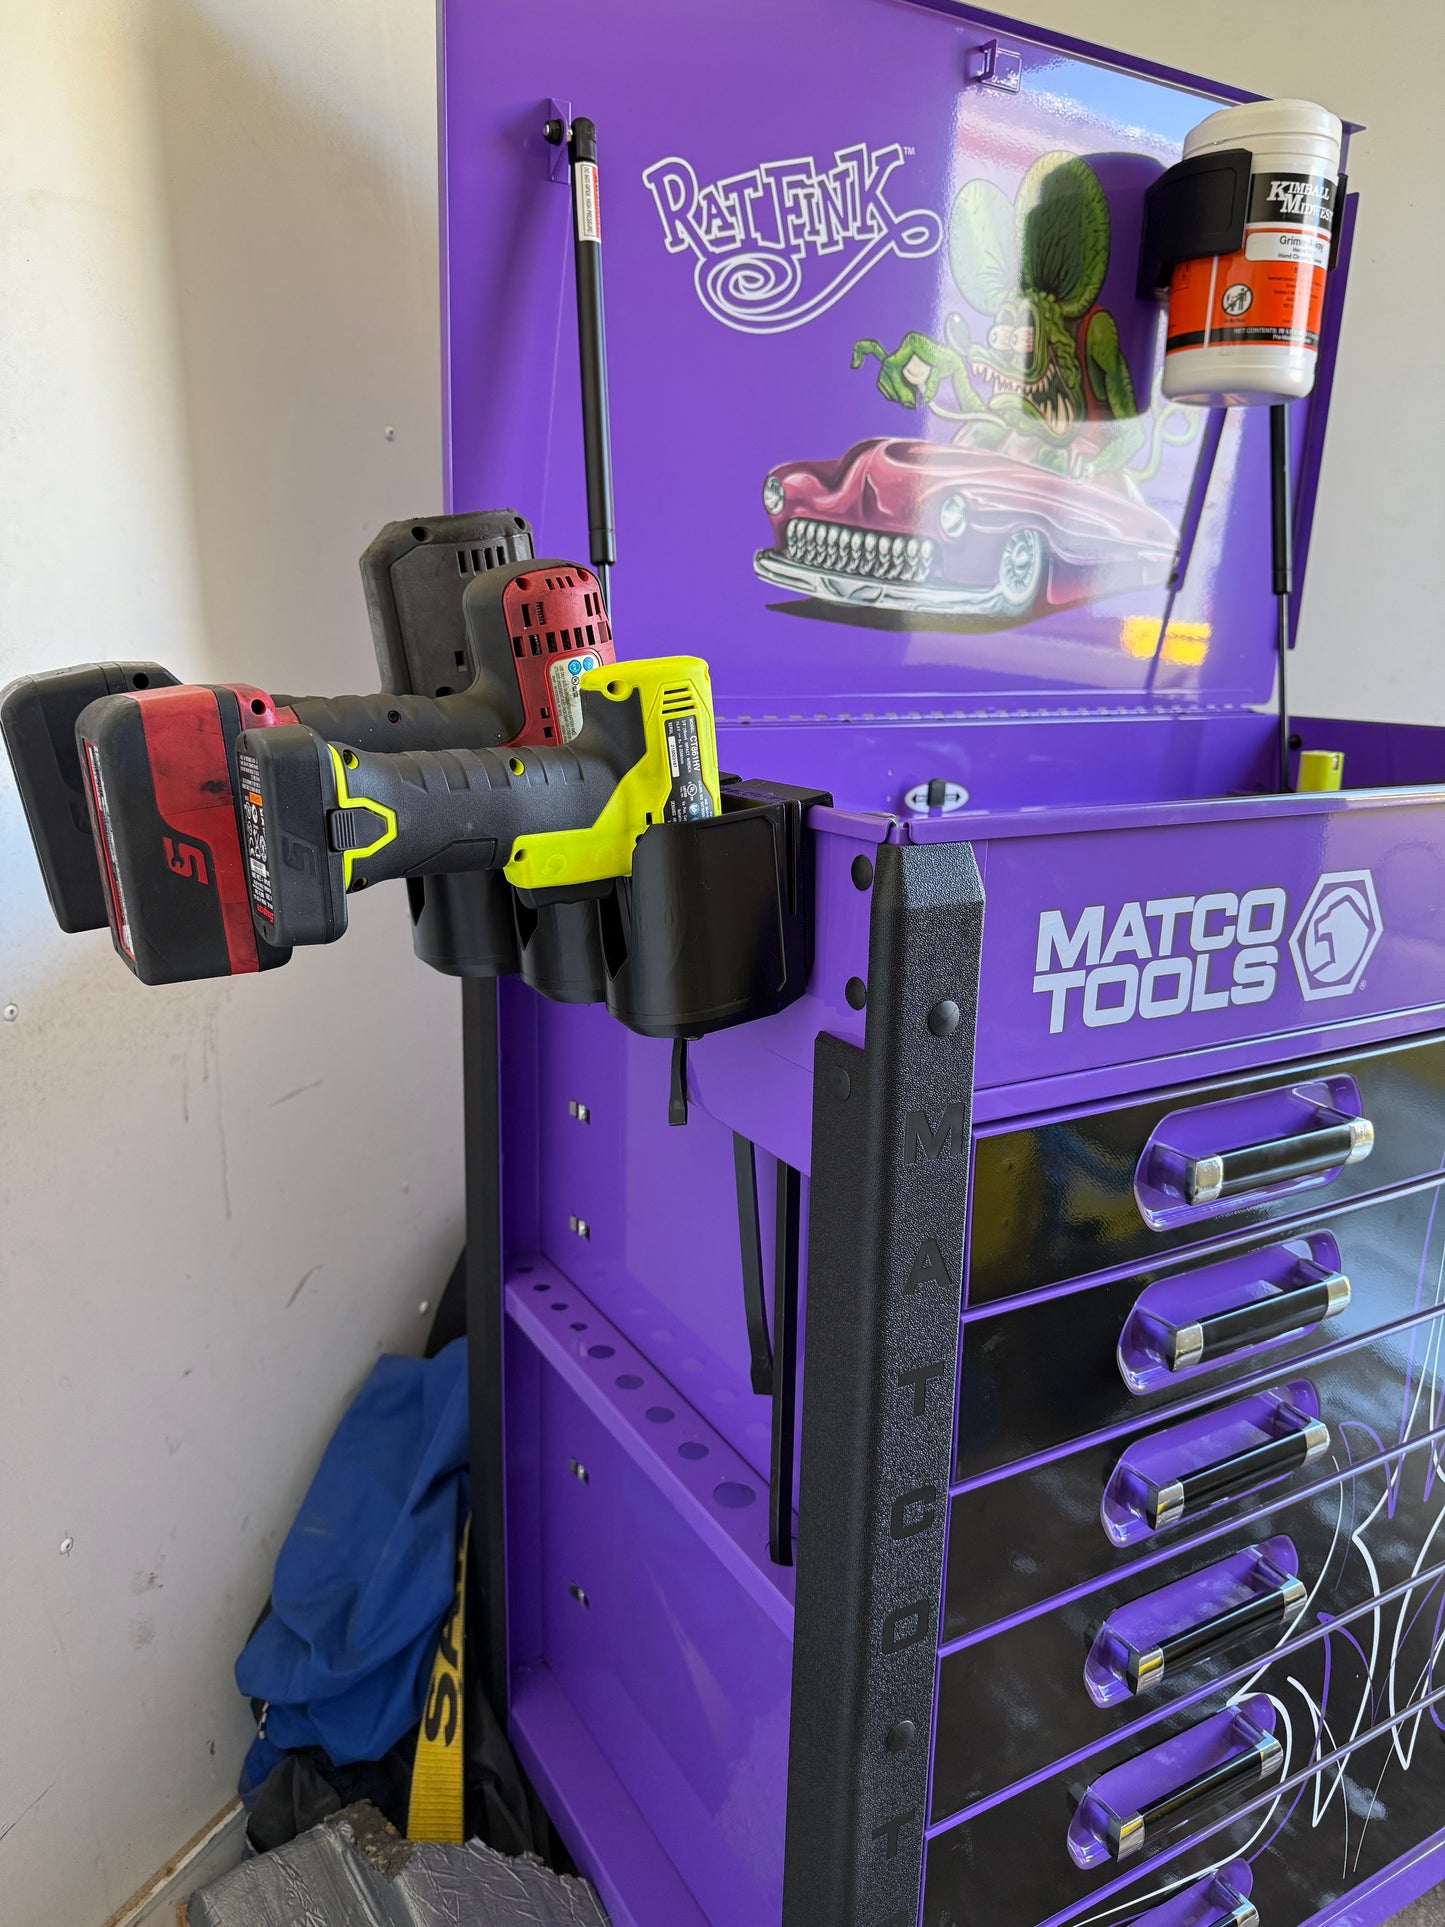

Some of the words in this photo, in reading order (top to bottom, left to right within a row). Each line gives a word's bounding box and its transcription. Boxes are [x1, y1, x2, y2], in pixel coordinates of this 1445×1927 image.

[690, 735, 701, 771] CT861HV
[1035, 887, 1287, 973] MATCO
[1031, 945, 1279, 1034] TOOLS
